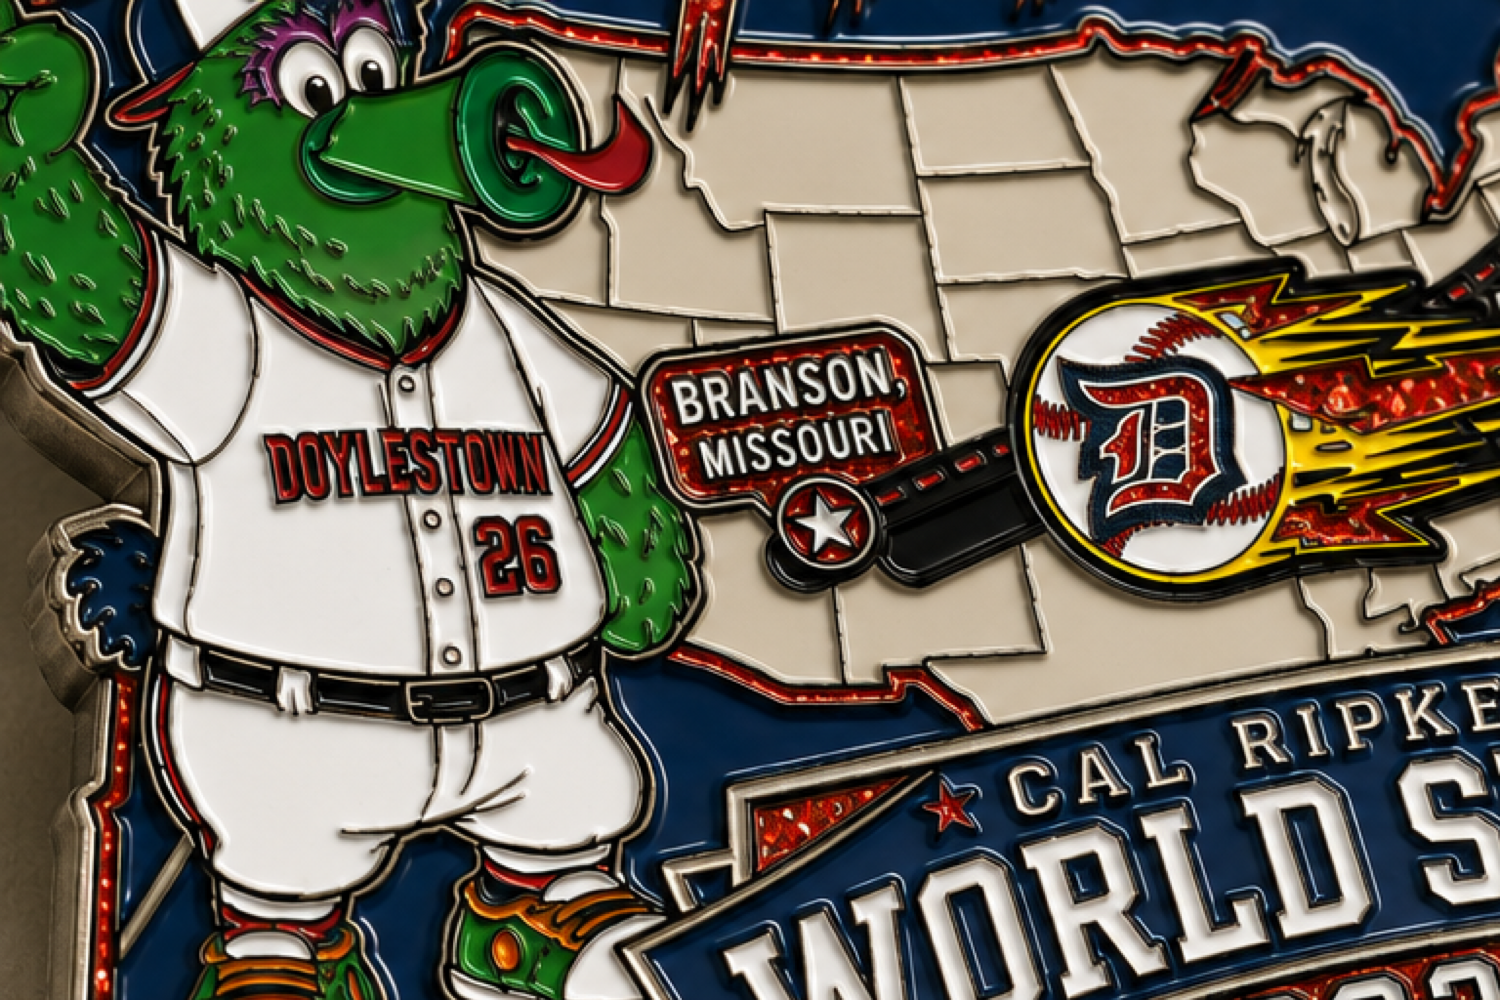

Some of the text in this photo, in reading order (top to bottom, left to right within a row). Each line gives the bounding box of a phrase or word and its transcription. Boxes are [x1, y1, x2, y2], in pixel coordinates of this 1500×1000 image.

[670, 352, 906, 426] BRANSON,
[263, 429, 553, 504] DOYLESTOWN
[698, 409, 897, 480] MISSOURI
[475, 515, 563, 598] 26
[1008, 734, 1190, 817] CAL
